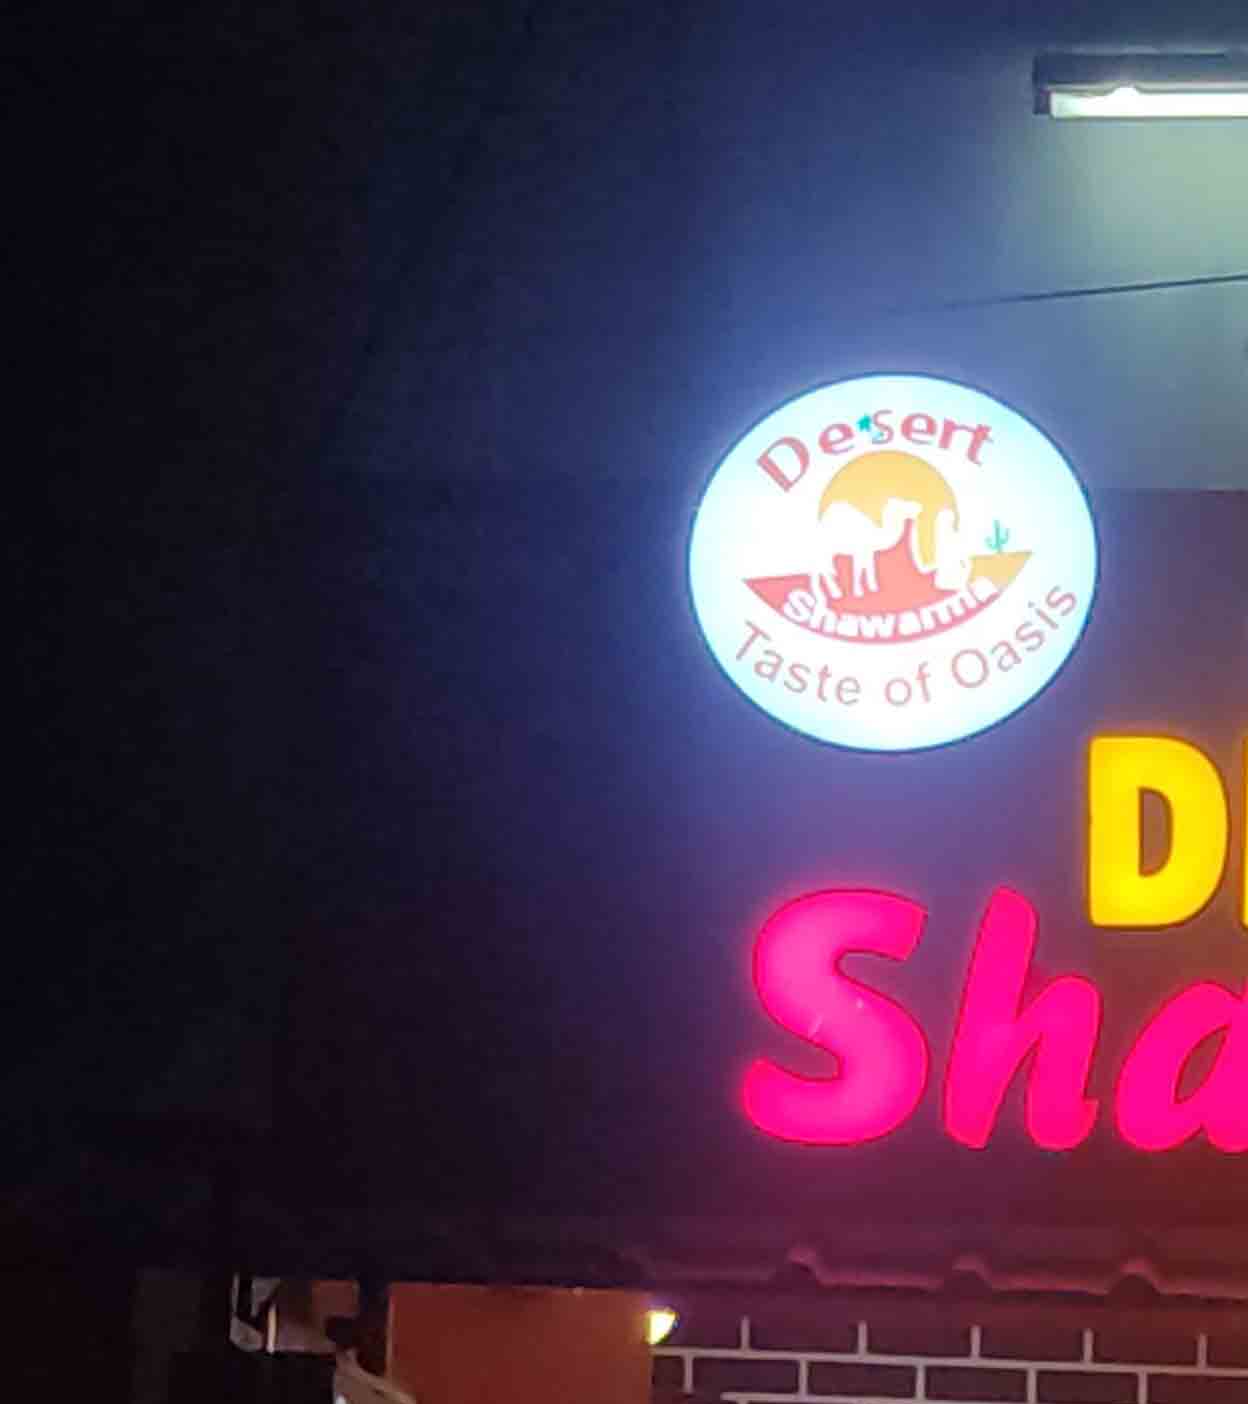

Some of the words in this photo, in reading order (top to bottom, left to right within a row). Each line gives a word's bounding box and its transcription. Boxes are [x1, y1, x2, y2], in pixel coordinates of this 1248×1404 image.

[756, 409, 994, 492] Desert
[735, 620, 861, 707] Taste
[884, 661, 932, 706] of
[950, 584, 1078, 688] Oasis
